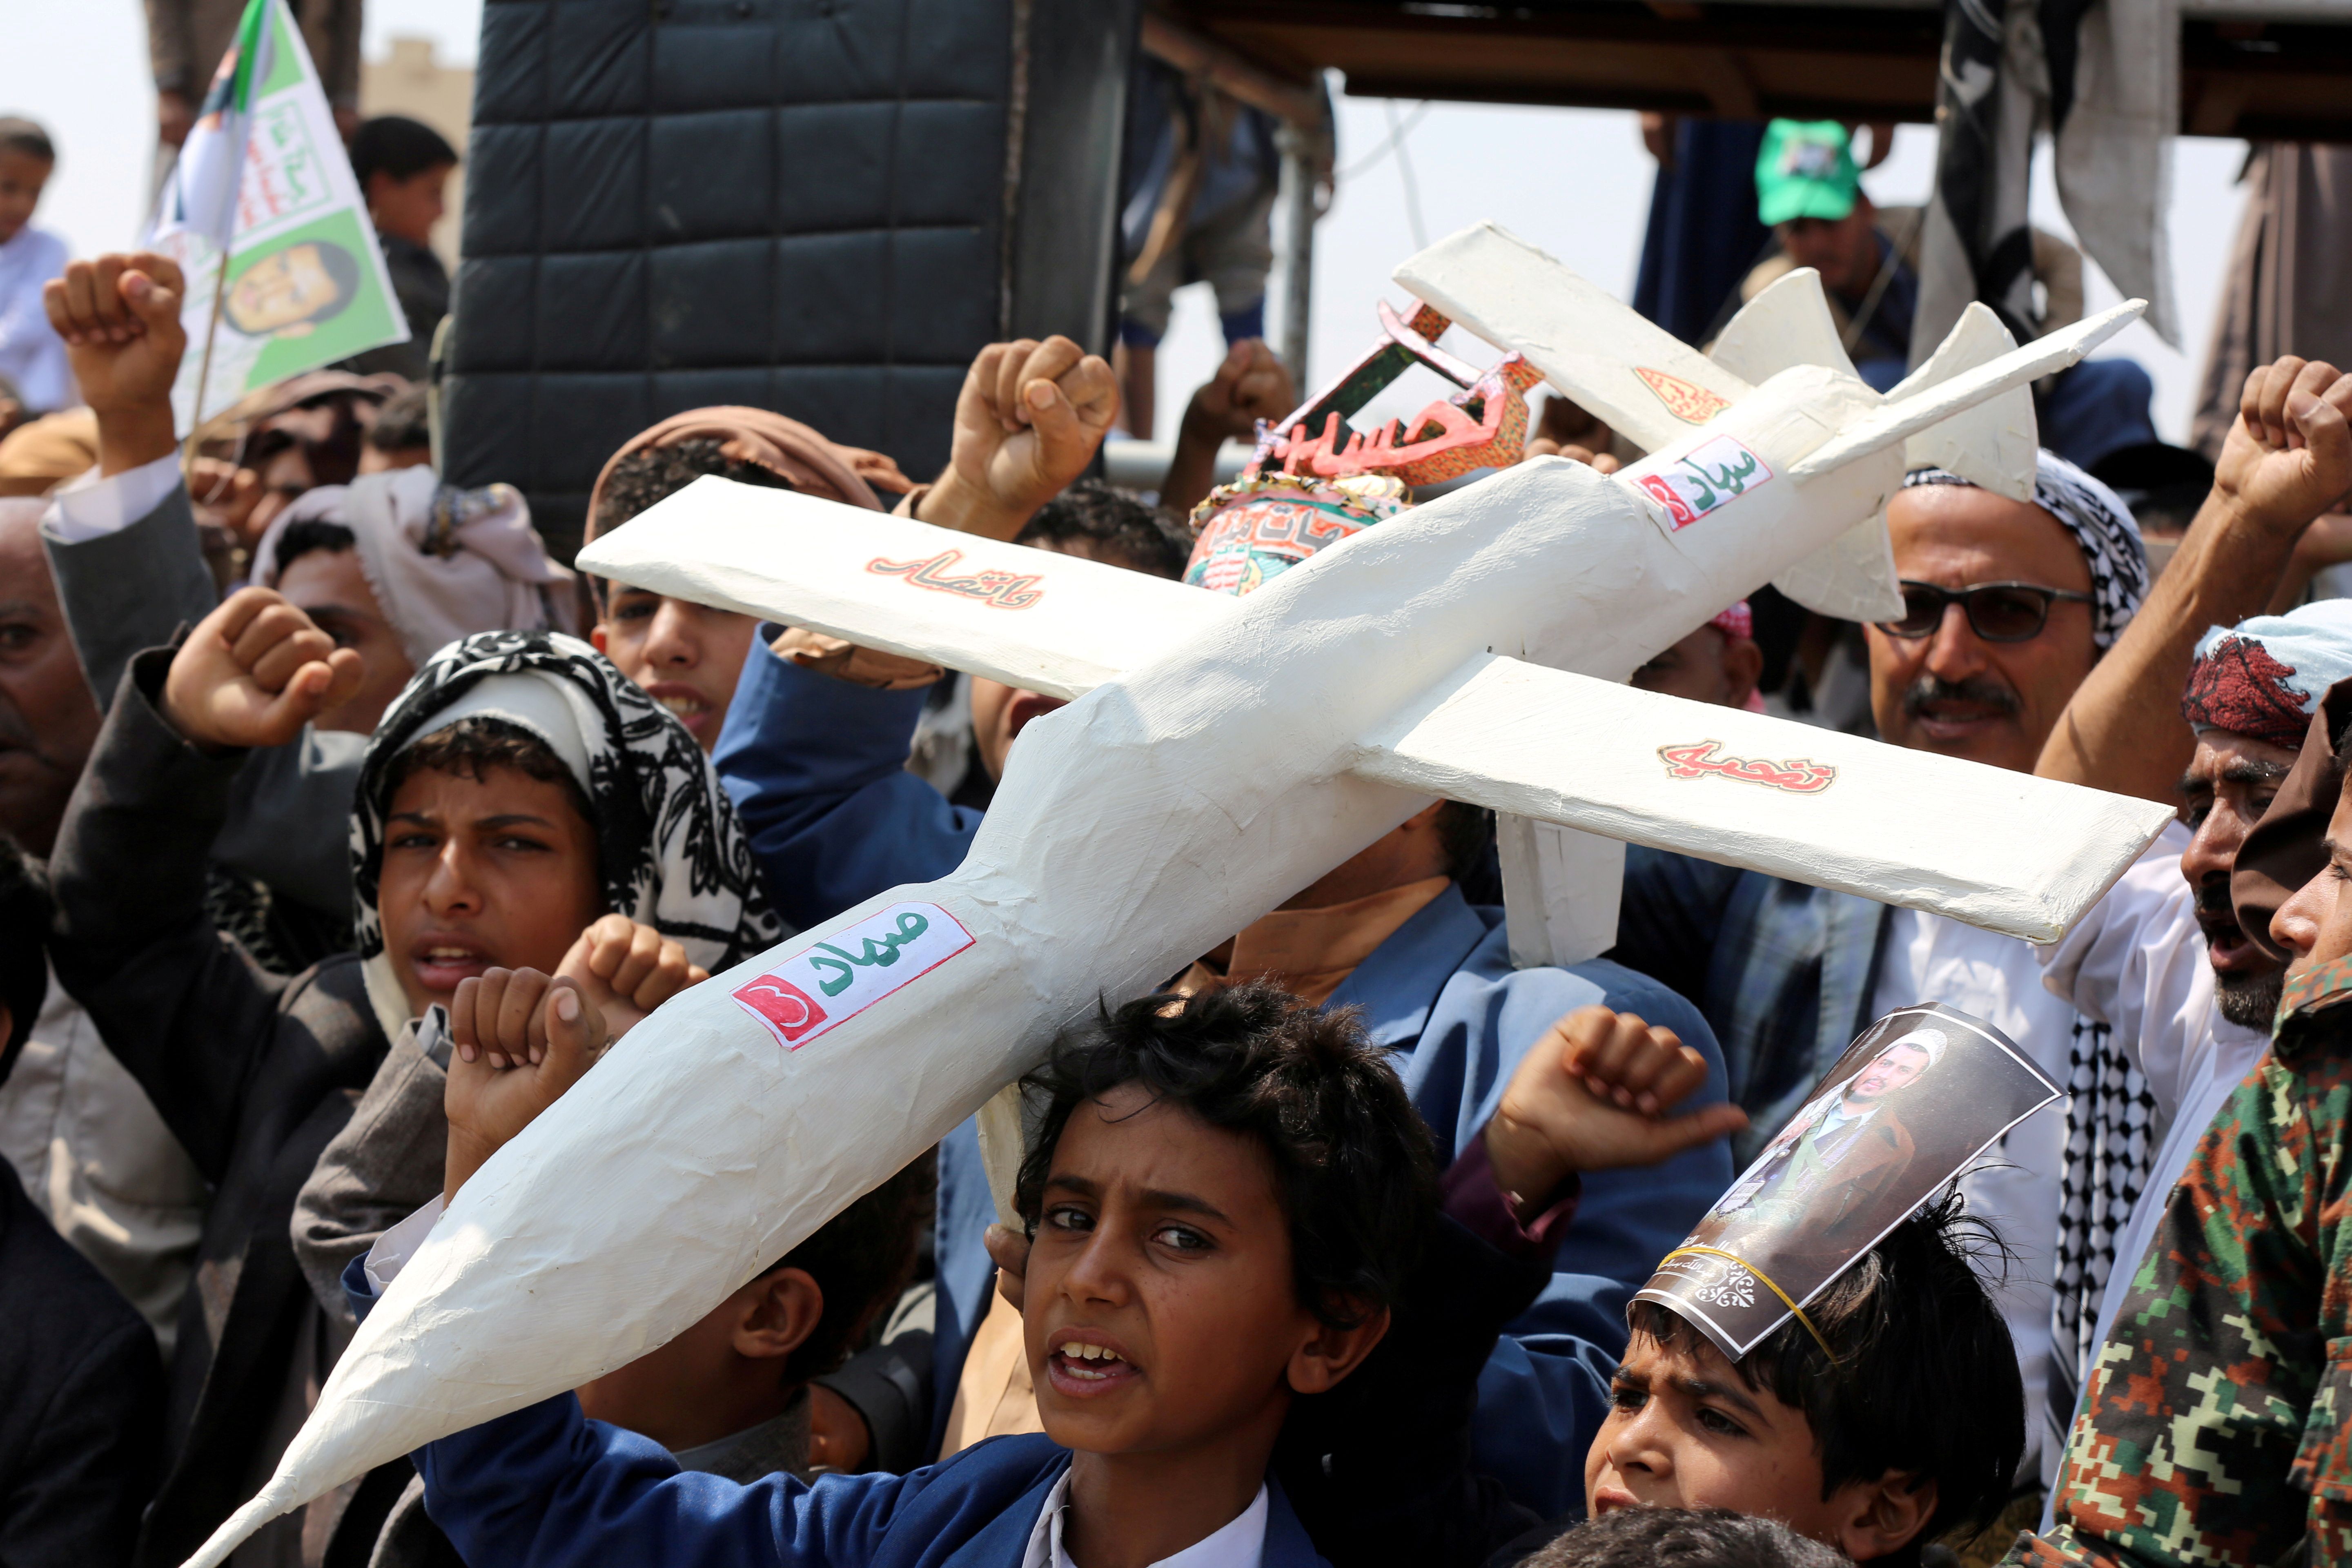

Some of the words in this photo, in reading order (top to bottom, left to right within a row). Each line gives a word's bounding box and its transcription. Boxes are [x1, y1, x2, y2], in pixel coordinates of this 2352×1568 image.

[1650, 483, 1689, 521] 3
[1682, 450, 1756, 511] صماد
[867, 549, 1043, 609] وانتصار
[808, 912, 929, 997] صماد
[747, 985, 810, 1028] 3
